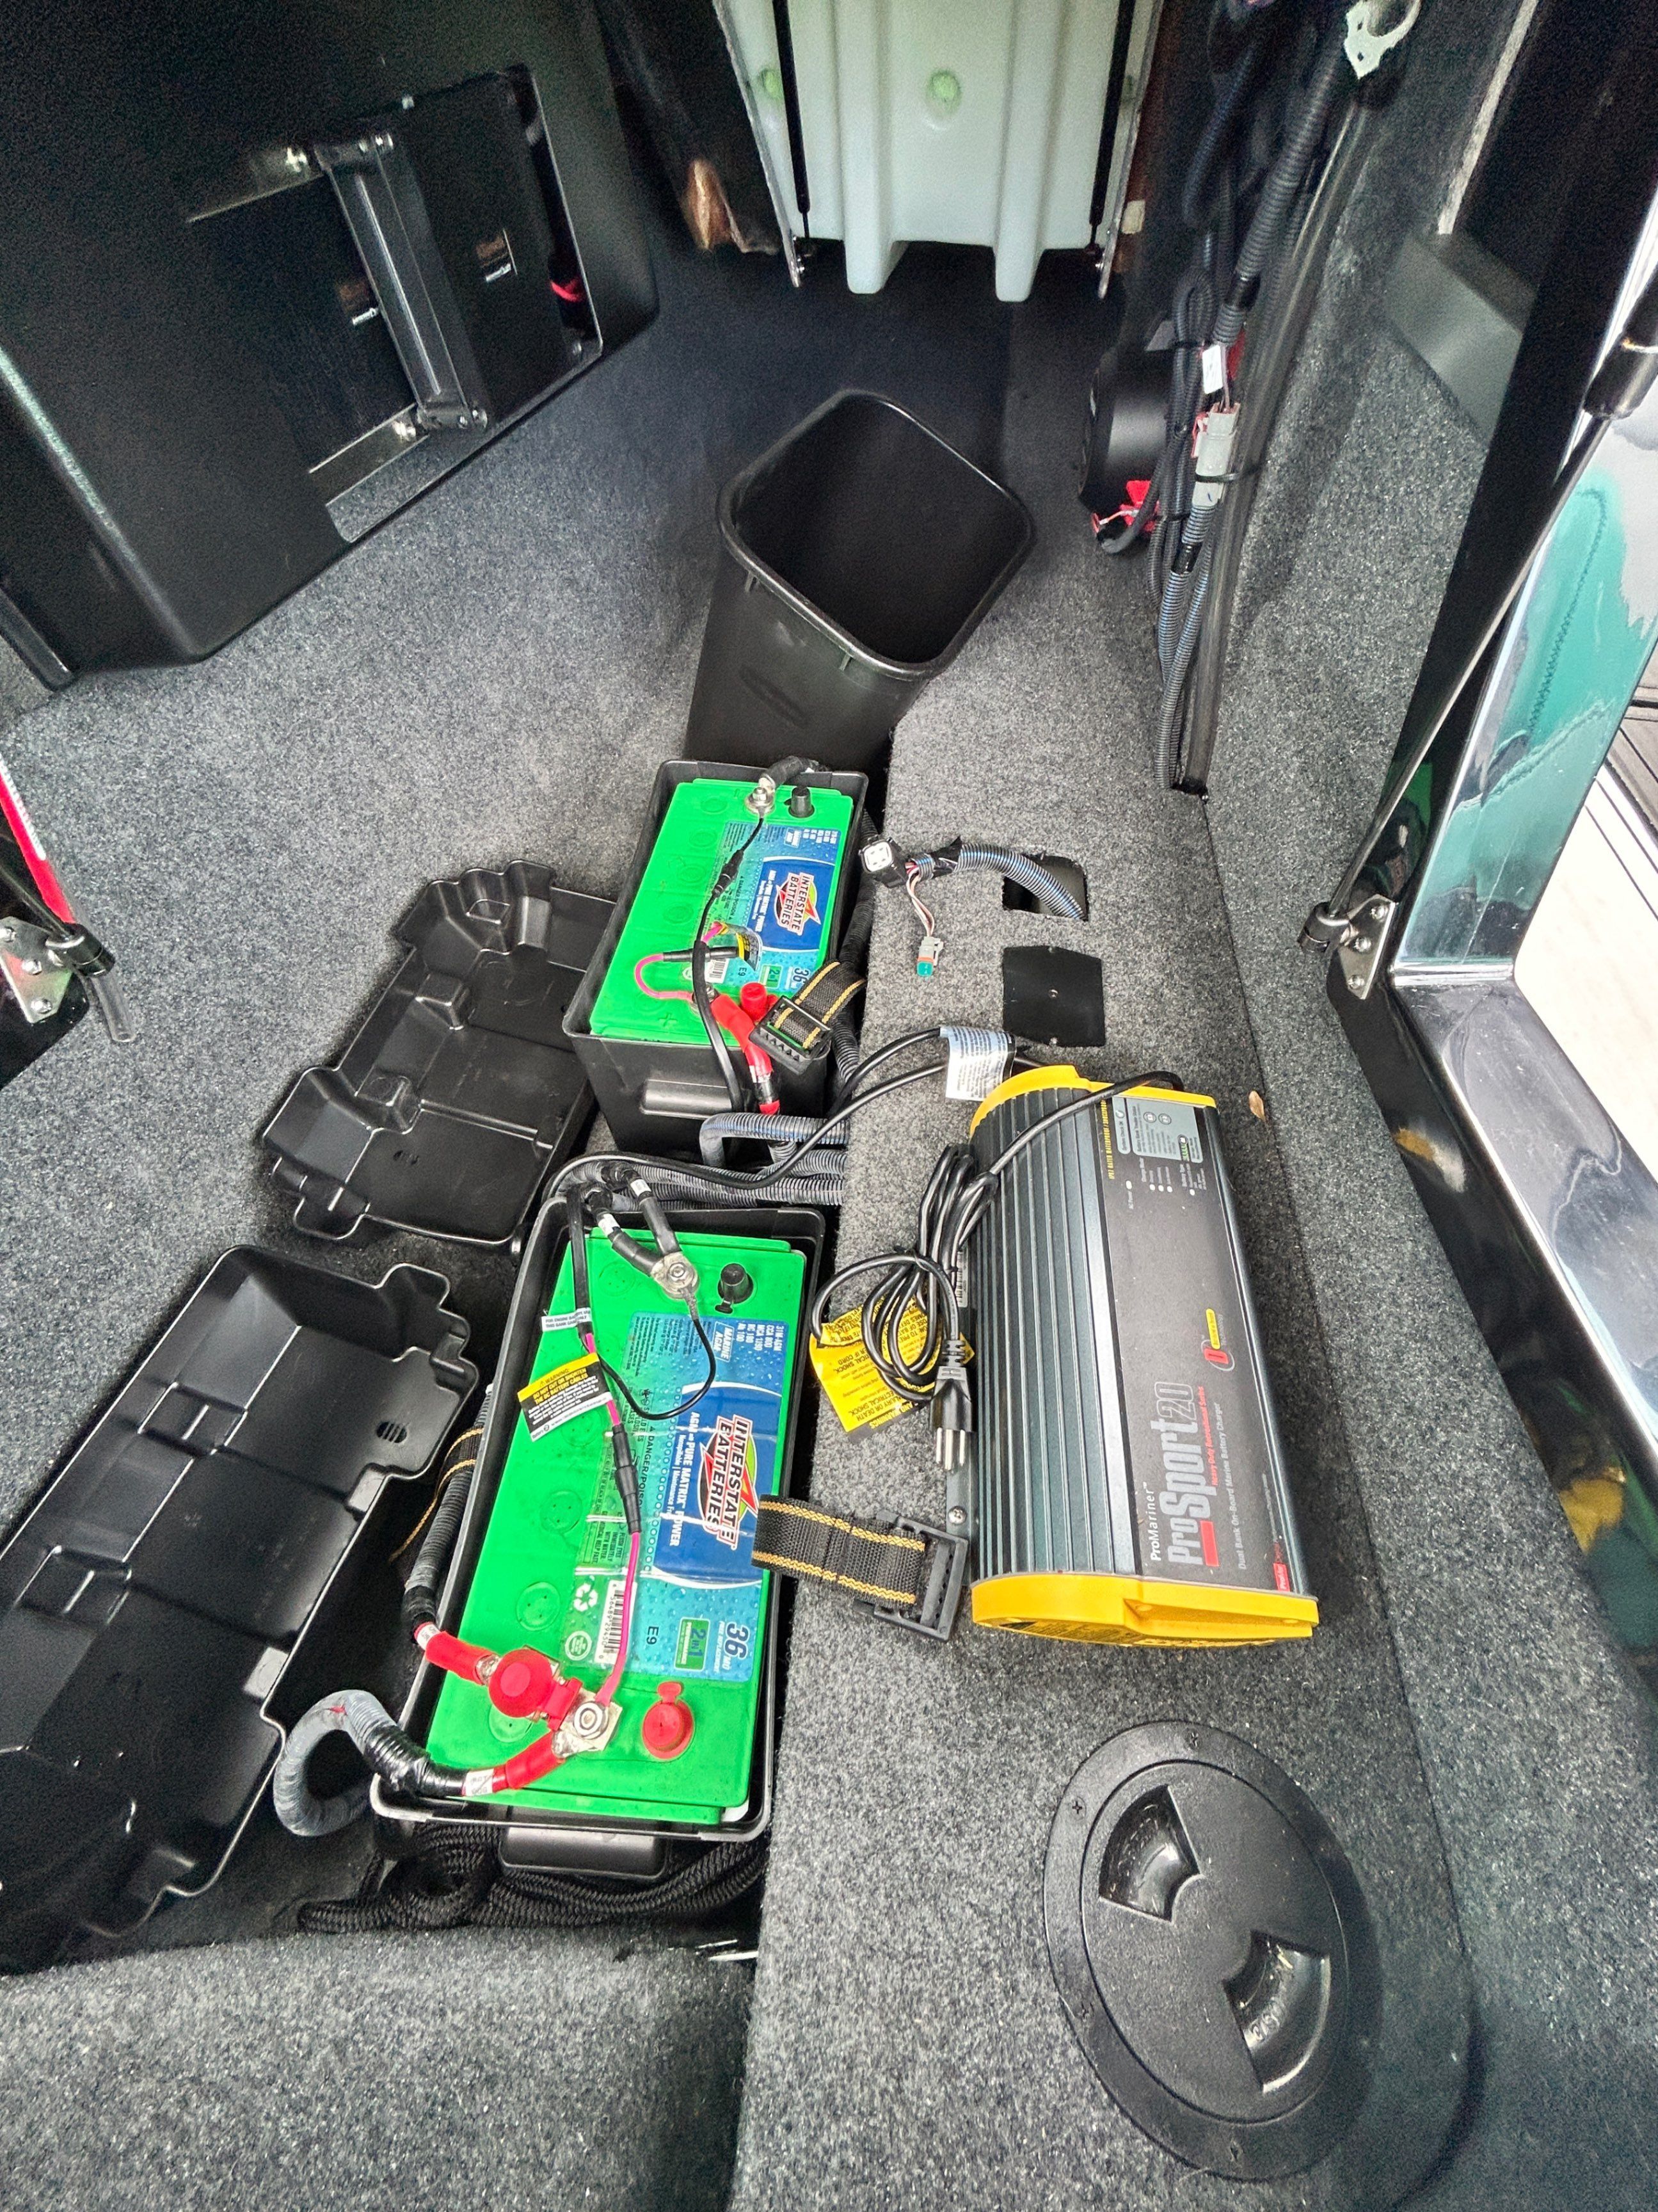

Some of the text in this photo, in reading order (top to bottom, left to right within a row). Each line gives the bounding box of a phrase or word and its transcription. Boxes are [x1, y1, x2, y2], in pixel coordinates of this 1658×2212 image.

[781, 877, 798, 925] BATTERIES
[792, 876, 810, 930] INTERSTATE
[738, 968, 747, 976] E9
[793, 968, 809, 982] 36
[713, 1331, 724, 1350] AGM
[736, 1331, 745, 1342] 100
[756, 1324, 765, 1336] MCA
[764, 1325, 774, 1348] CCA 800
[774, 1326, 784, 1351] 31M-AGM
[720, 1327, 733, 1359] MARINE
[838, 1354, 853, 1365] CORD
[869, 1390, 894, 1406] ECTRICAL
[689, 1412, 699, 1432] AGM
[856, 1409, 875, 1422] DEATH
[1197, 1386, 1218, 1486] Heavy Duty Recreational Series
[674, 1434, 686, 1465] Nonspillable
[683, 1441, 696, 1465] PURE
[639, 1436, 655, 1510] DANGER/POISO
[706, 1423, 732, 1531] BATTERIES
[721, 1420, 748, 1539] INTERSTATE
[1213, 1402, 1247, 1569] Dual Bank On-Board Marine Battery Charger
[667, 1470, 680, 1505] Maintenance
[669, 1511, 685, 1546] POWER
[594, 1540, 603, 1551] HELP
[607, 1532, 618, 1562] IMMEDIATELY
[646, 1626, 658, 1645] E9
[722, 1623, 749, 1670] 36 MO
